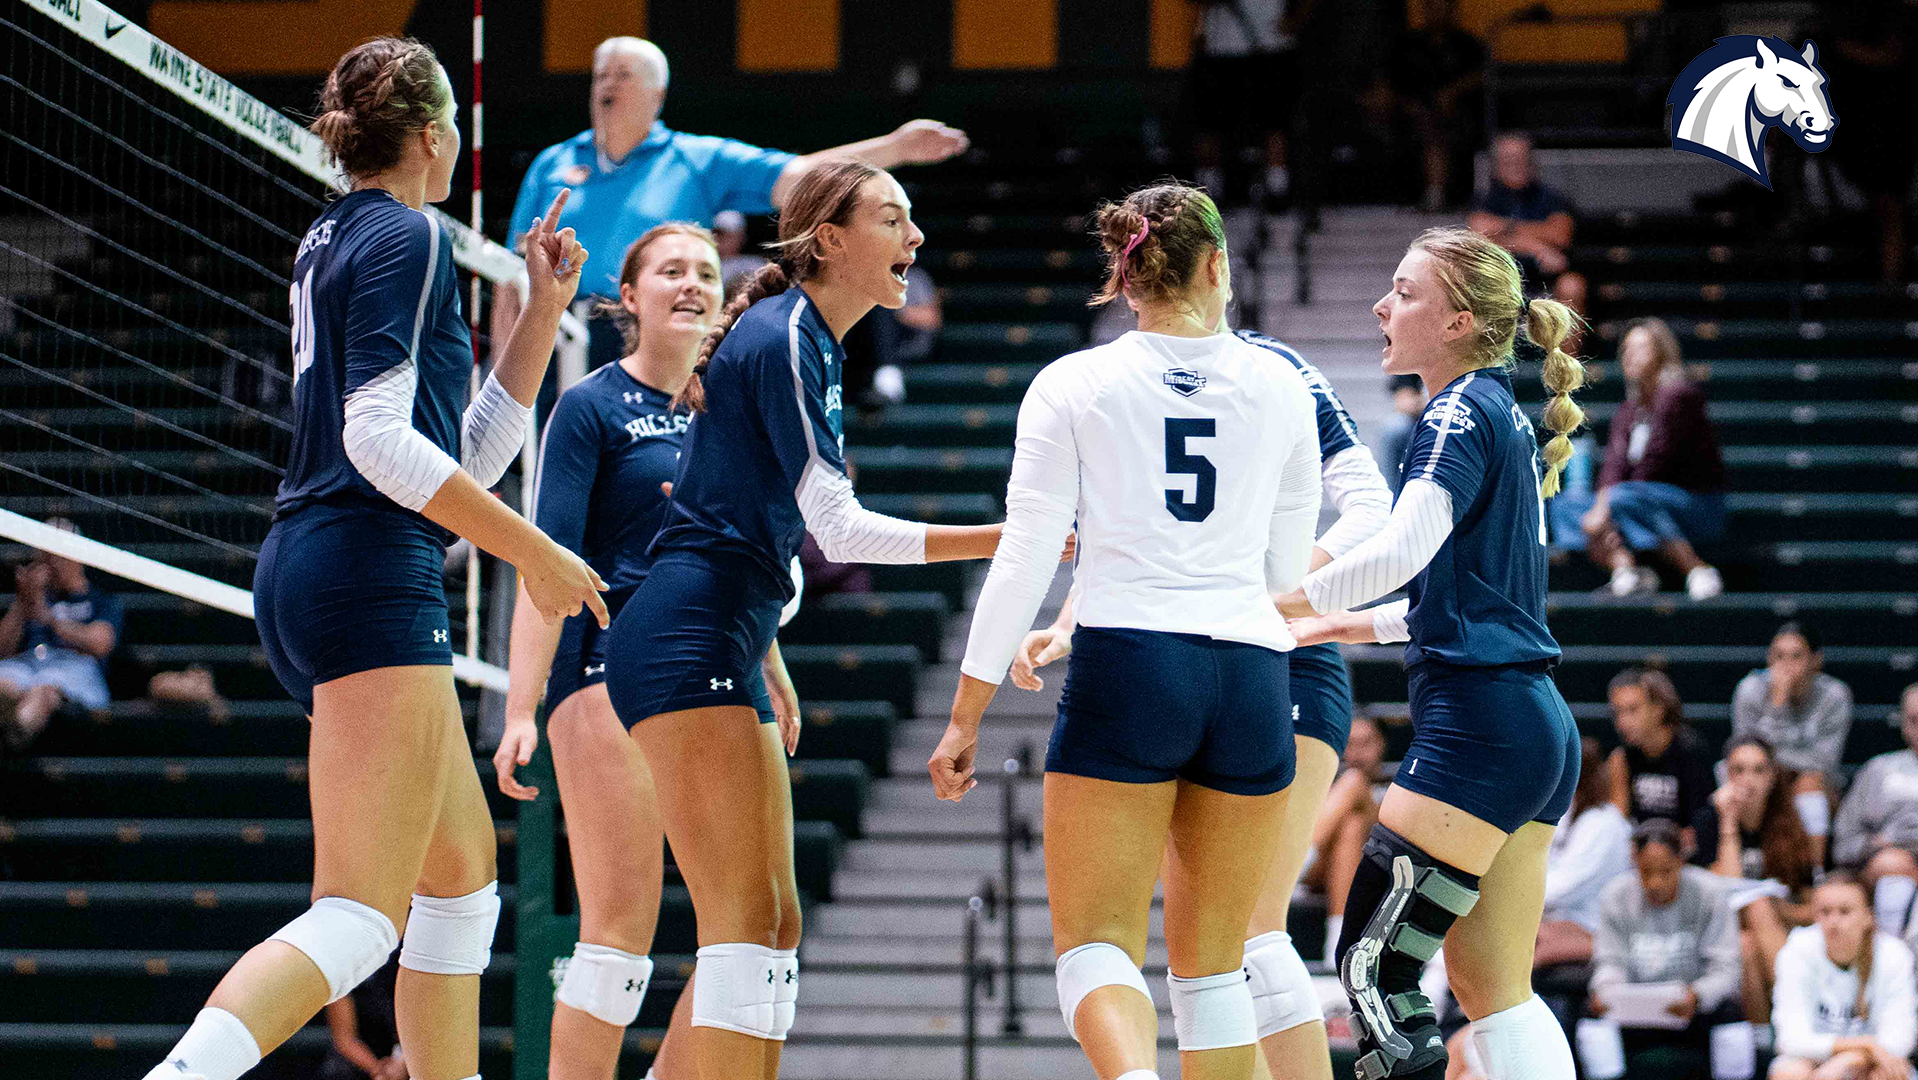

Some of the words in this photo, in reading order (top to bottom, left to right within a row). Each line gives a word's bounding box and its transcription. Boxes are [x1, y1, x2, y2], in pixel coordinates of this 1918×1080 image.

[149, 40, 191, 88] WAYNE
[194, 62, 233, 112] STATE
[235, 93, 303, 155] VOLLEYBALL
[625, 409, 696, 442] HILLS
[1423, 407, 1476, 430] MIDEST
[1164, 417, 1217, 522] 5
[1408, 758, 1419, 775] 1
[1390, 892, 1409, 921] TITANIUM
